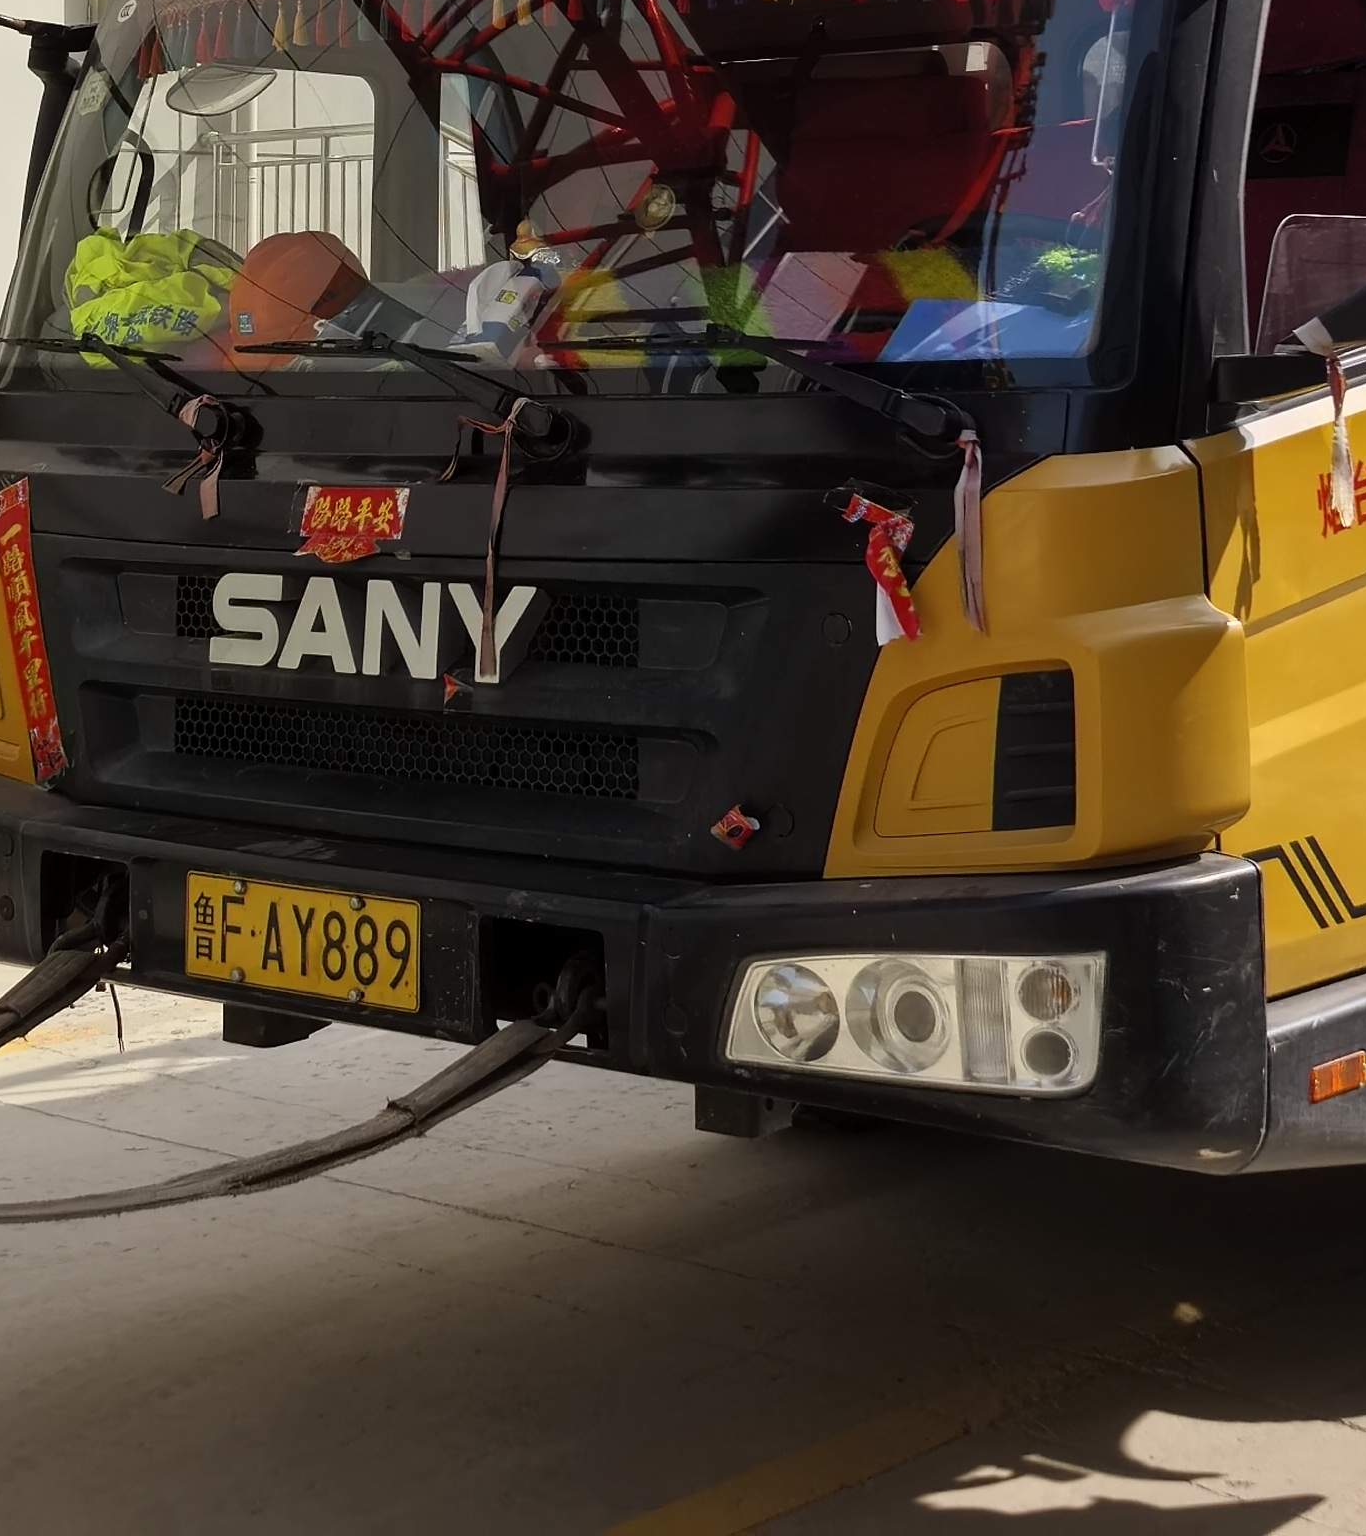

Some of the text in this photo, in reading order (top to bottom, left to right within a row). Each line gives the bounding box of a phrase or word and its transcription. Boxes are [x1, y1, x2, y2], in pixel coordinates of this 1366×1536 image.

[310, 495, 395, 535] 路路平安
[208, 572, 538, 684] SANY
